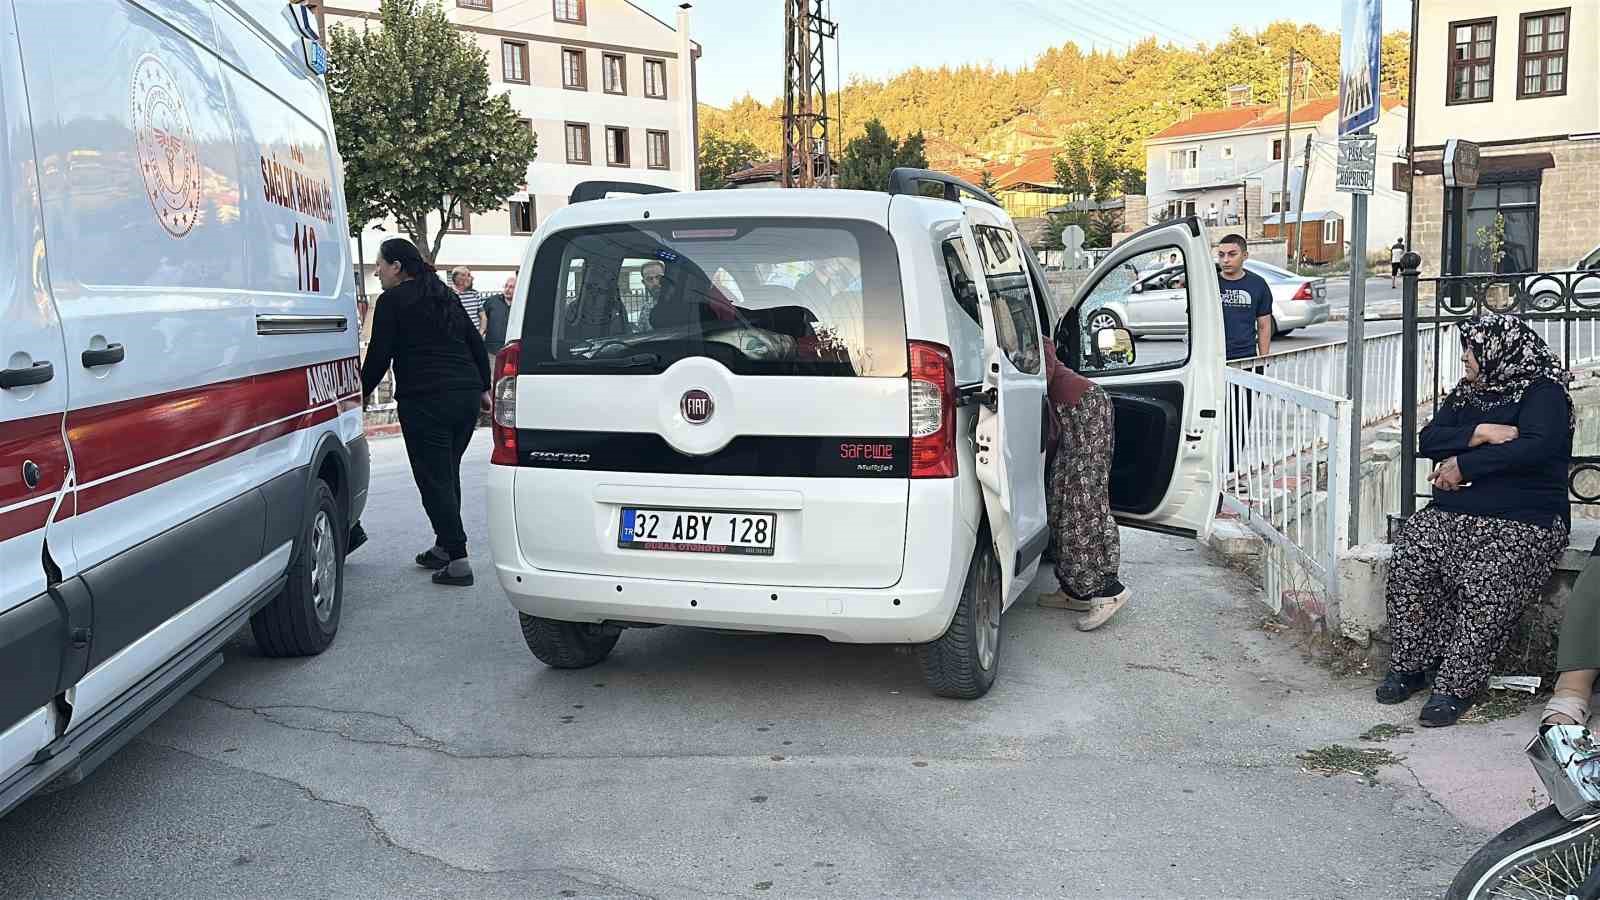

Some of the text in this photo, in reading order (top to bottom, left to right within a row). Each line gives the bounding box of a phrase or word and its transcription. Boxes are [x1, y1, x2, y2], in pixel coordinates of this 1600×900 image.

[294, 222, 320, 292] 112
[306, 358, 361, 406] AMBULANS
[687, 398, 708, 415] FIAT
[624, 527, 634, 536] TR
[634, 513, 768, 544] 32 ABY 128
